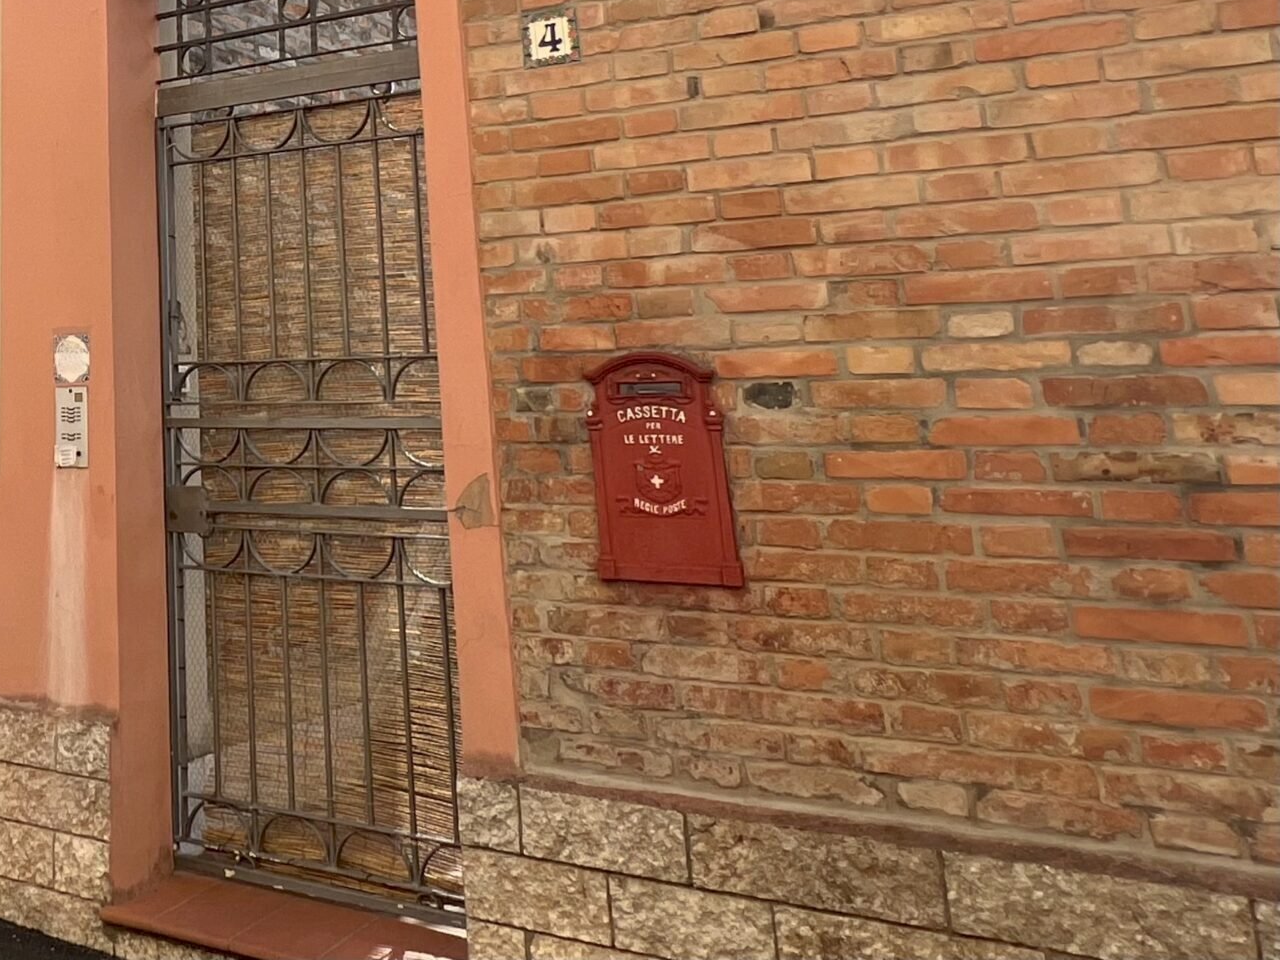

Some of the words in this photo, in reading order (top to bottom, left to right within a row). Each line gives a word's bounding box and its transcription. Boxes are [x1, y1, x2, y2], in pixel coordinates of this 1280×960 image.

[538, 22, 563, 53] 4
[617, 405, 686, 423] CASSETTA
[624, 434, 635, 444] LE
[639, 434, 684, 444] LETTERE
[634, 498, 659, 514] REGIE
[663, 499, 687, 514] POSTE
